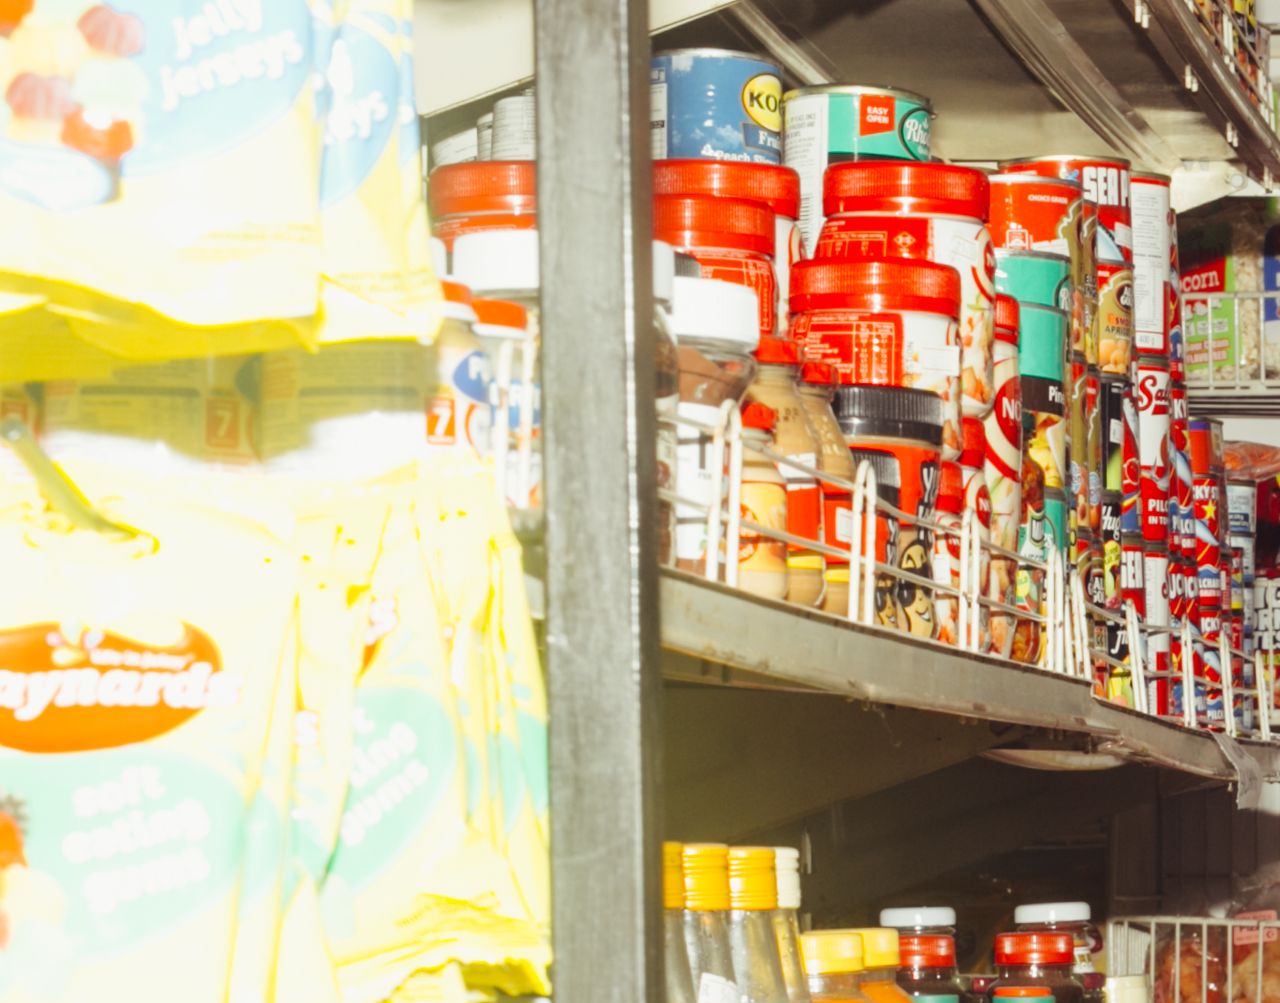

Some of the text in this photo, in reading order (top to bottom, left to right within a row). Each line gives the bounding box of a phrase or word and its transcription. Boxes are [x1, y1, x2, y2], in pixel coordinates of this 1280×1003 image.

[748, 90, 783, 113] KO
[867, 106, 888, 116] EASY
[866, 114, 889, 124] OPEN
[1083, 167, 1115, 205] SEA
[0, 664, 241, 722] aynards
